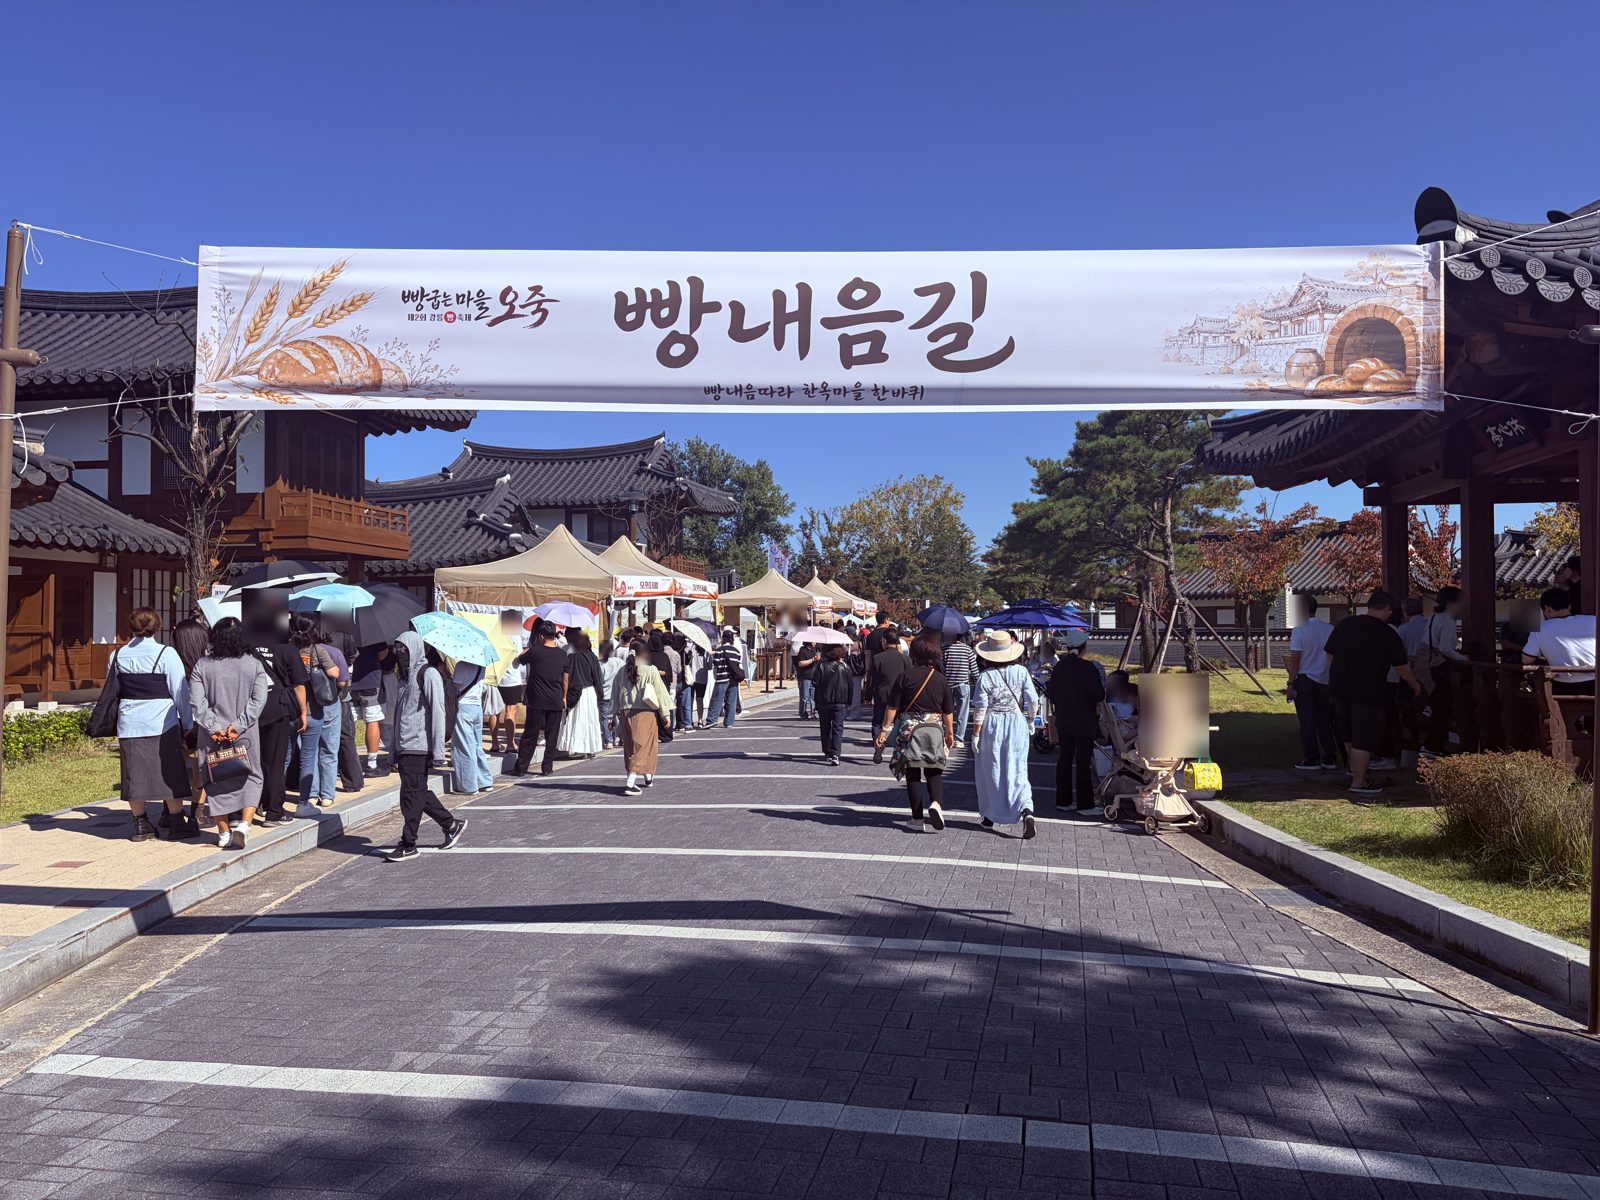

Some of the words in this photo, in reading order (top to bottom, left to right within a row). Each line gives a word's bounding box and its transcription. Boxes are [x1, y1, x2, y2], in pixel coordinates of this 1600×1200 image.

[401, 286, 454, 312] 빵굽는
[455, 288, 493, 321] 마을
[486, 285, 561, 329] 오죽
[407, 313, 427, 321] 제2회
[613, 270, 1015, 373] 빵내음길
[703, 383, 794, 401] 빵내음따라
[802, 381, 865, 401] 한옥마을
